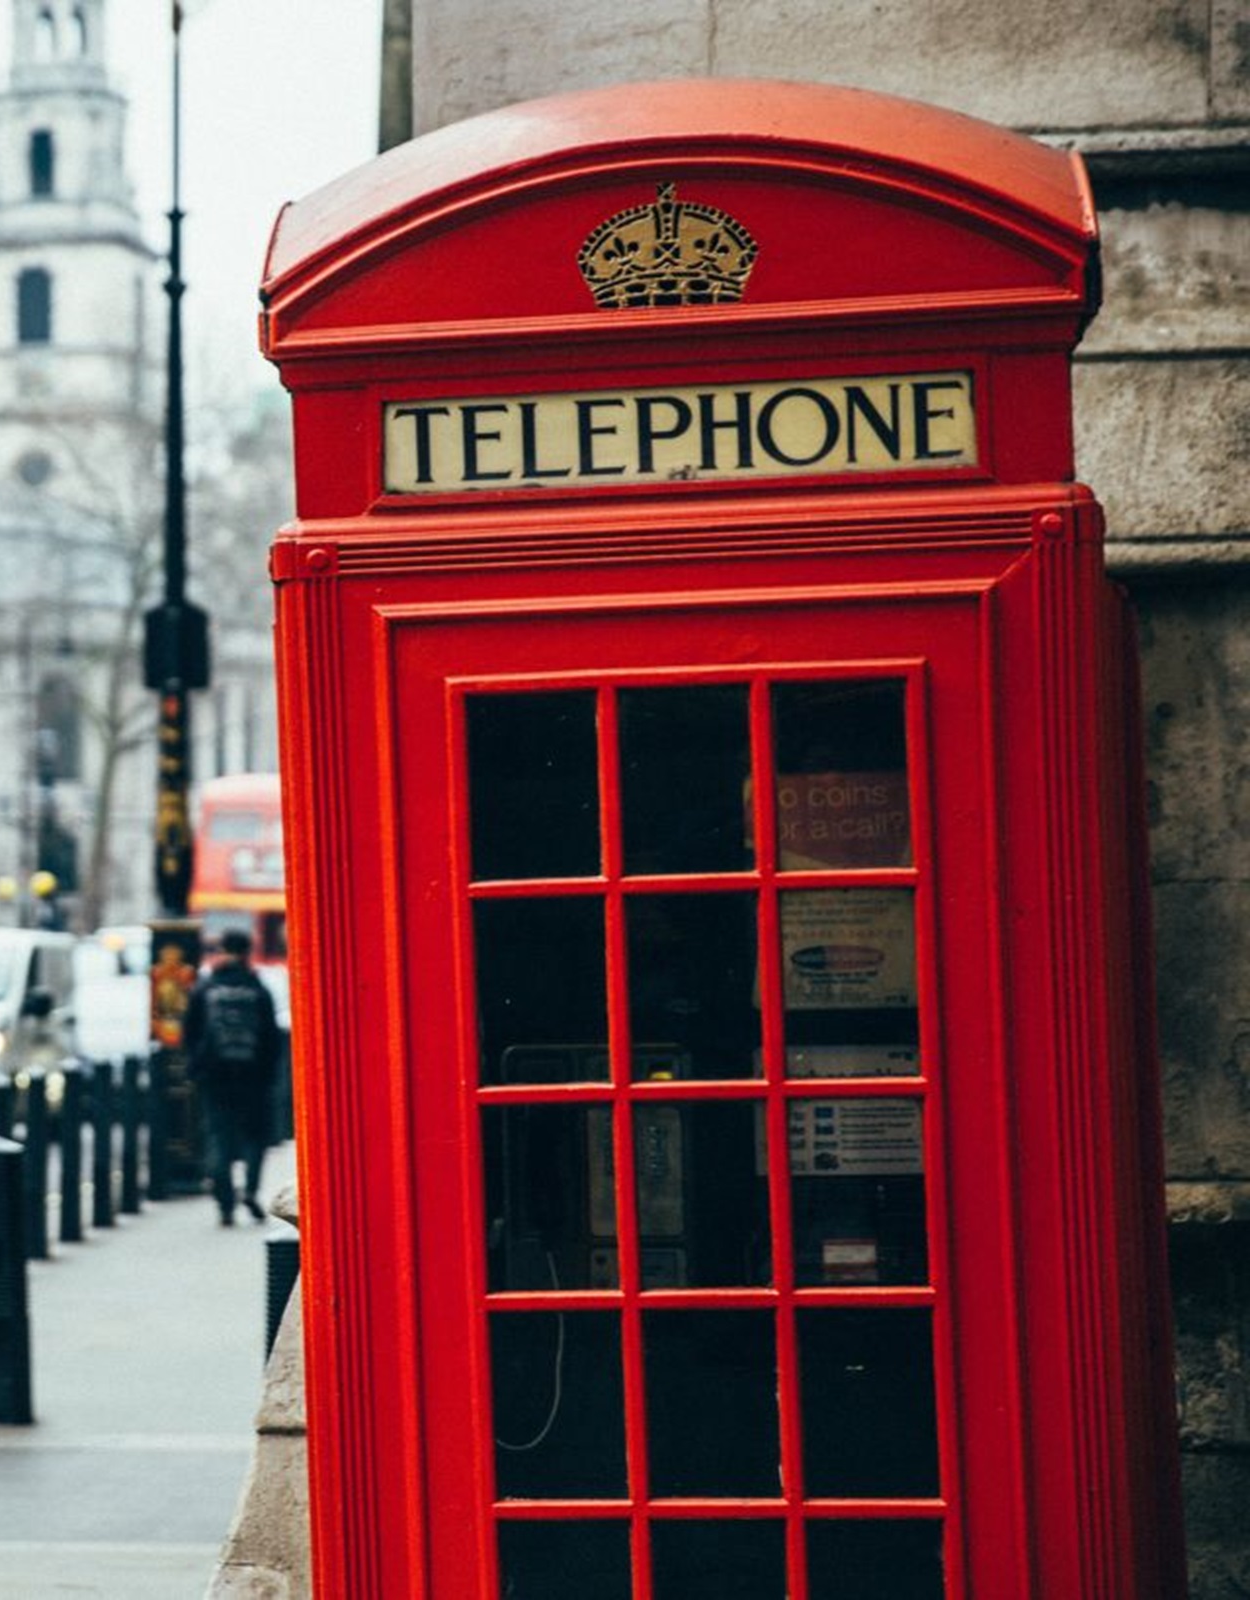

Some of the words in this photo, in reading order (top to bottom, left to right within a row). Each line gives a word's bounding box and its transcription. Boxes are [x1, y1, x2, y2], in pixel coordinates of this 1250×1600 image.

[393, 381, 964, 483] TELEPHONE
[808, 782, 888, 808] coins
[809, 819, 828, 839] a
[839, 811, 905, 839] call?
